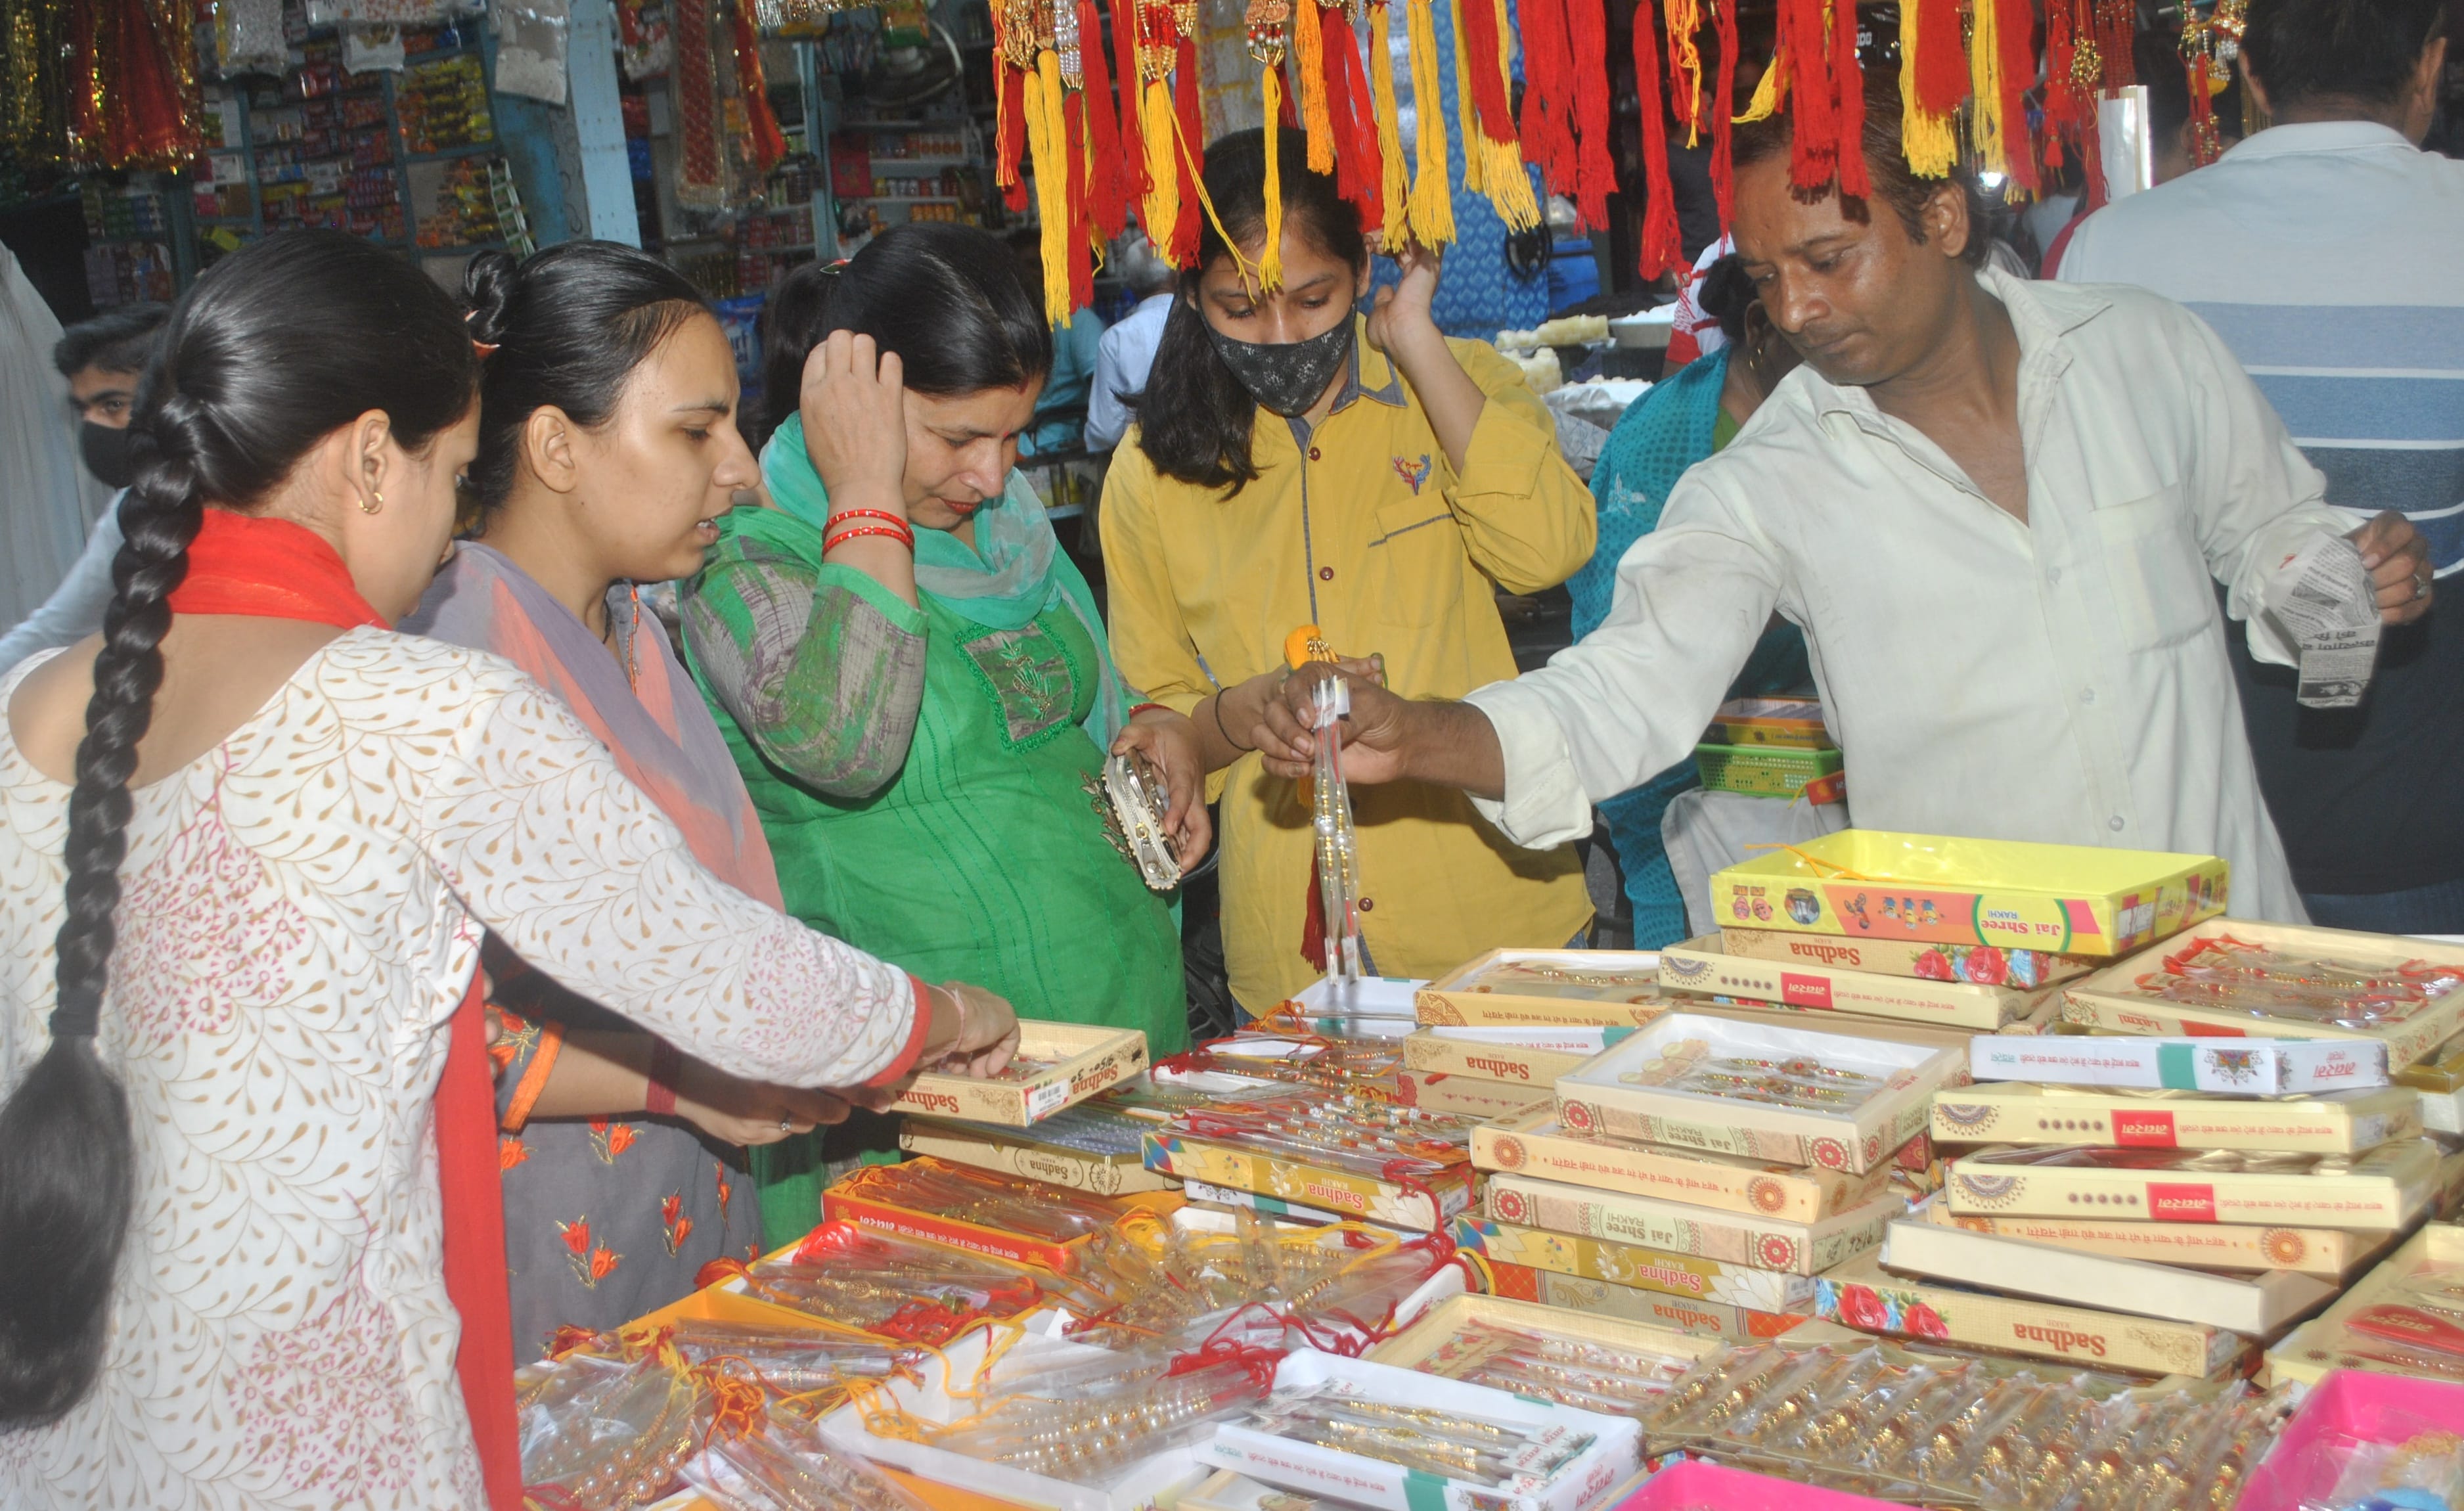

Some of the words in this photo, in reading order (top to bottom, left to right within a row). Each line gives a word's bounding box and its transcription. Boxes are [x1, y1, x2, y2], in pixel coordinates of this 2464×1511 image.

[1988, 911, 2018, 919] RAKHI
[1981, 920, 2028, 934] Shree
[2035, 924, 2061, 936] Jai
[1789, 942, 1861, 966] Sadhna
[1787, 983, 1826, 995] नवरंग
[1466, 1056, 1530, 1080] Sadhna
[2312, 1062, 2356, 1080] नवरंग
[1073, 1064, 1117, 1094] Sadhna
[895, 1090, 959, 1114] Sadhna
[1667, 1125, 1703, 1137] RAKHI
[1668, 1132, 1706, 1146] Shree
[1710, 1139, 1730, 1150] Jai
[1551, 1156, 1578, 1169] नवरंग
[1030, 1160, 1068, 1180] Sadhna
[1321, 1177, 1348, 1190] RAKHI
[1307, 1183, 1363, 1210] Sadhna
[1607, 1213, 1644, 1227] RAKHI
[1606, 1222, 1645, 1240] Shree
[1651, 1230, 1672, 1244] Jai
[2026, 1227, 2058, 1239] नवरंग
[1655, 1258, 1684, 1271] RAKHI
[1639, 1265, 1701, 1292] Sadhna
[1671, 1300, 1698, 1311] RAKHI
[1653, 1304, 1721, 1332] Sadhna
[2013, 1323, 2106, 1357] Sadhna
